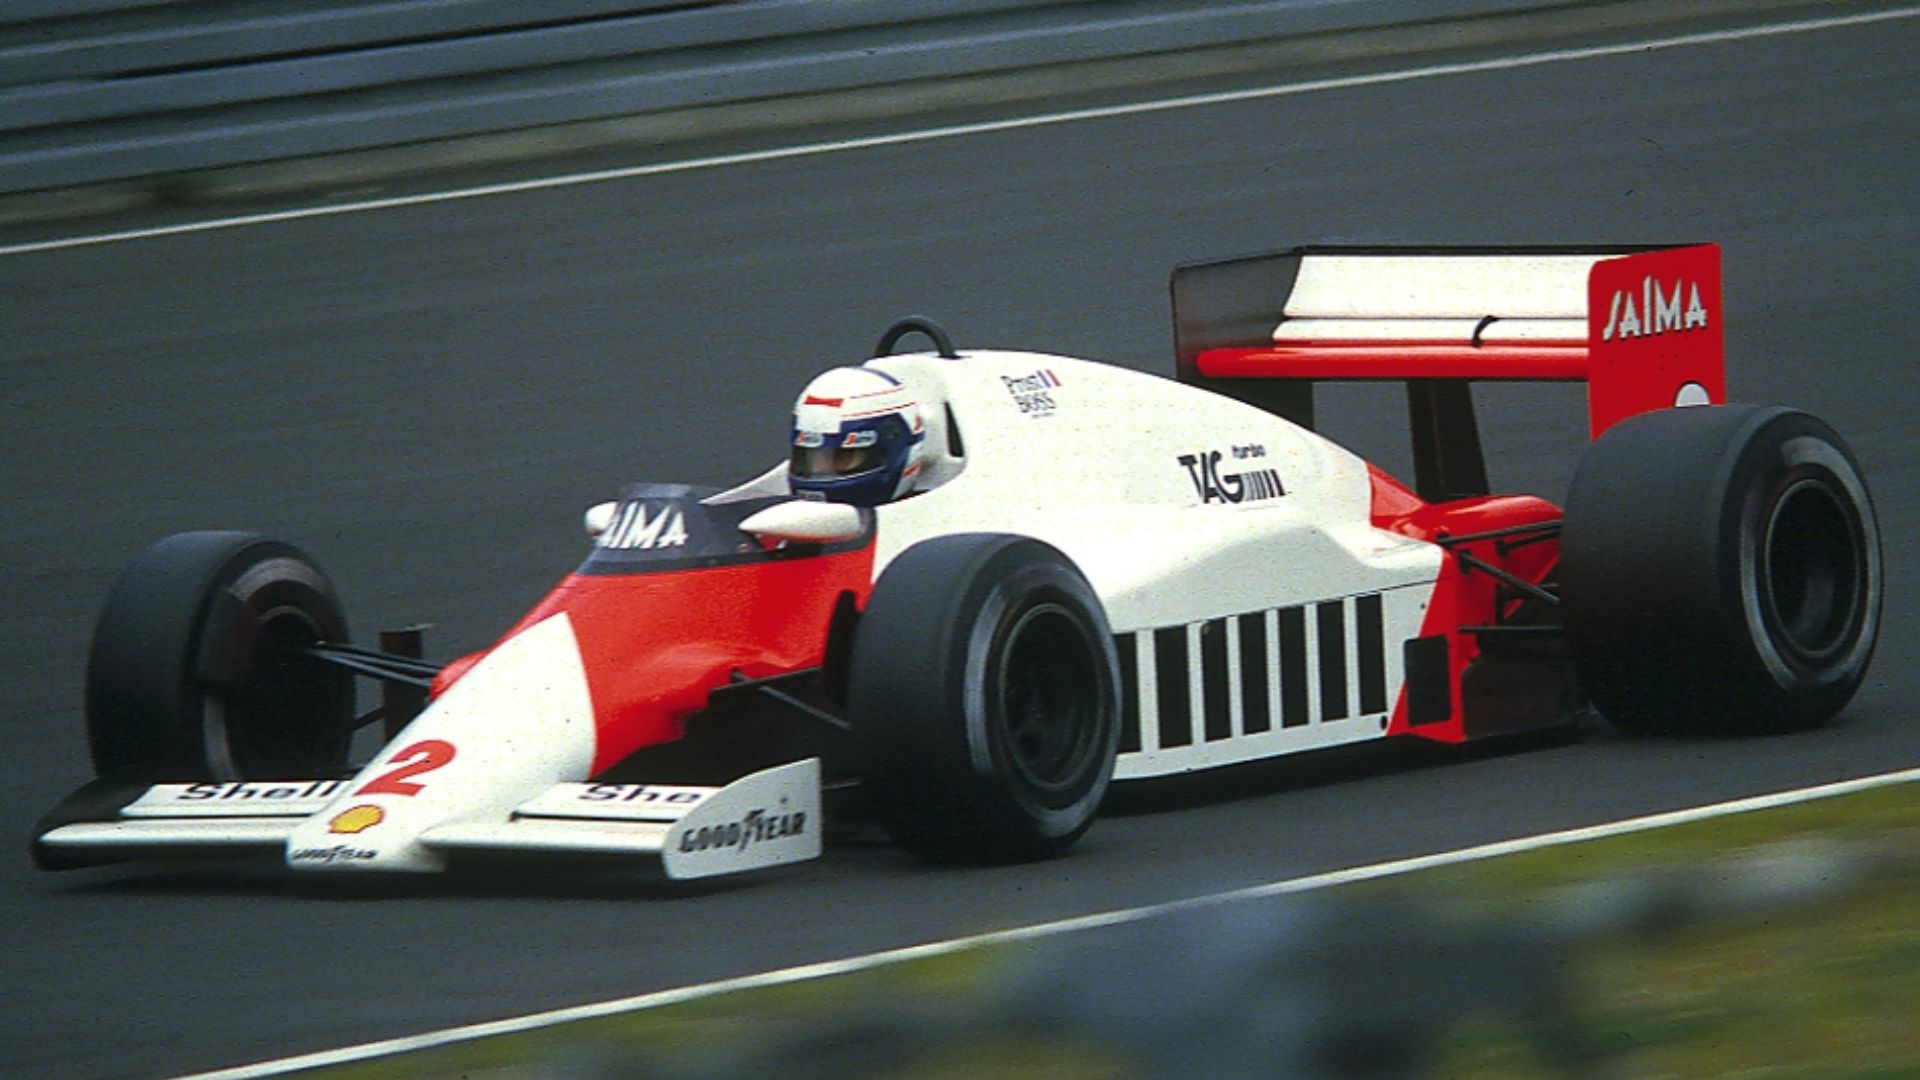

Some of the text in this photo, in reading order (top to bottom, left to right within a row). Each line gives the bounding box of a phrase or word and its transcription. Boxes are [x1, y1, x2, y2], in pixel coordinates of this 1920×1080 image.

[1603, 275, 1707, 341] SAIMA
[1177, 450, 1244, 504] TAG
[178, 782, 341, 799] Shell
[354, 739, 457, 796] 2
[677, 808, 806, 853] GOODYEAR
